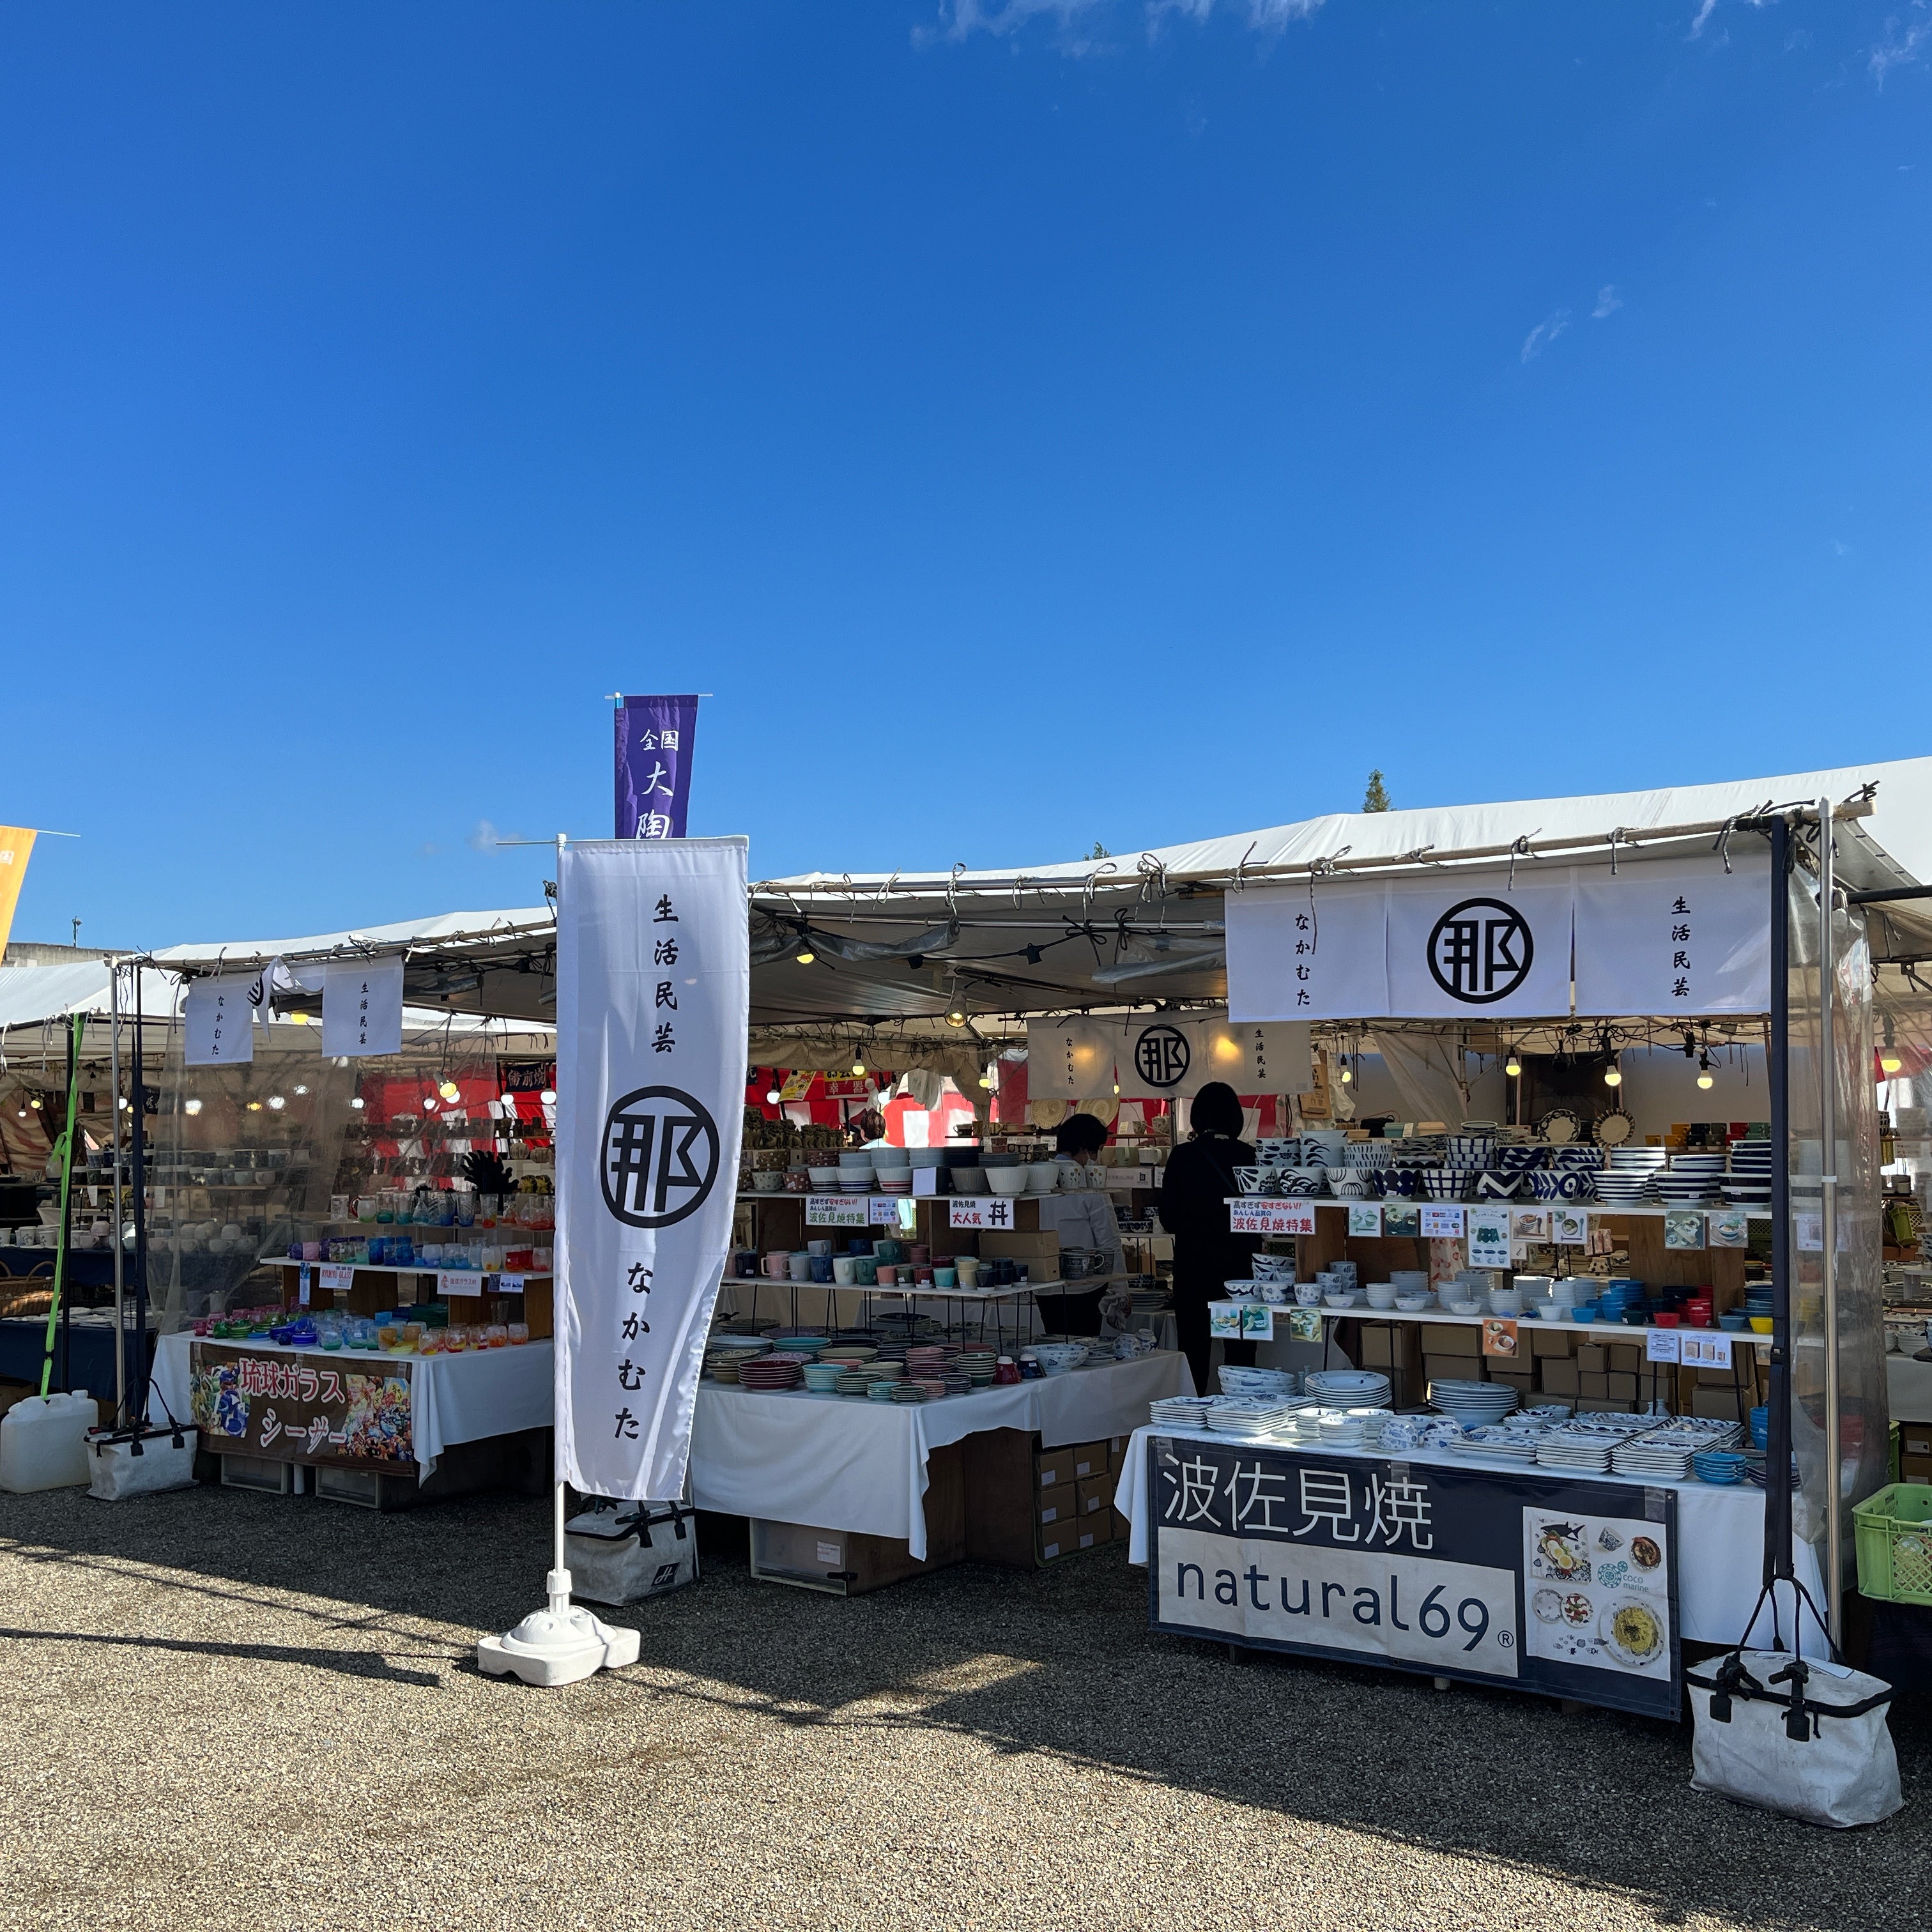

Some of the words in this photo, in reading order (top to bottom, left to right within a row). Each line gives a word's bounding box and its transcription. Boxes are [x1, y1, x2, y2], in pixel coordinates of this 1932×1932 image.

[640, 729, 678, 751] 全国
[1295, 914, 1310, 1006] なかむた
[1438, 914, 1524, 997] 那
[1671, 896, 1690, 997] 生活民芸
[651, 894, 678, 1054] 生活民芸
[211, 995, 224, 1055] なかむた
[359, 981, 369, 1045] 生活民芸
[1066, 1037, 1074, 1085] なかむた
[1255, 1028, 1266, 1078] 生活民芸
[809, 1212, 865, 1224] 波佐見焼特集
[953, 1212, 981, 1225] 大人気
[988, 1200, 1008, 1225] 丼
[1233, 1217, 1313, 1232] 波佐見焼特集
[615, 1262, 653, 1439] なかむた
[239, 1357, 345, 1404] 琉球ガラス
[260, 1407, 348, 1455] シーサー
[1163, 1453, 1433, 1550] 波佐見焼
[1623, 1583, 1649, 1593] marine
